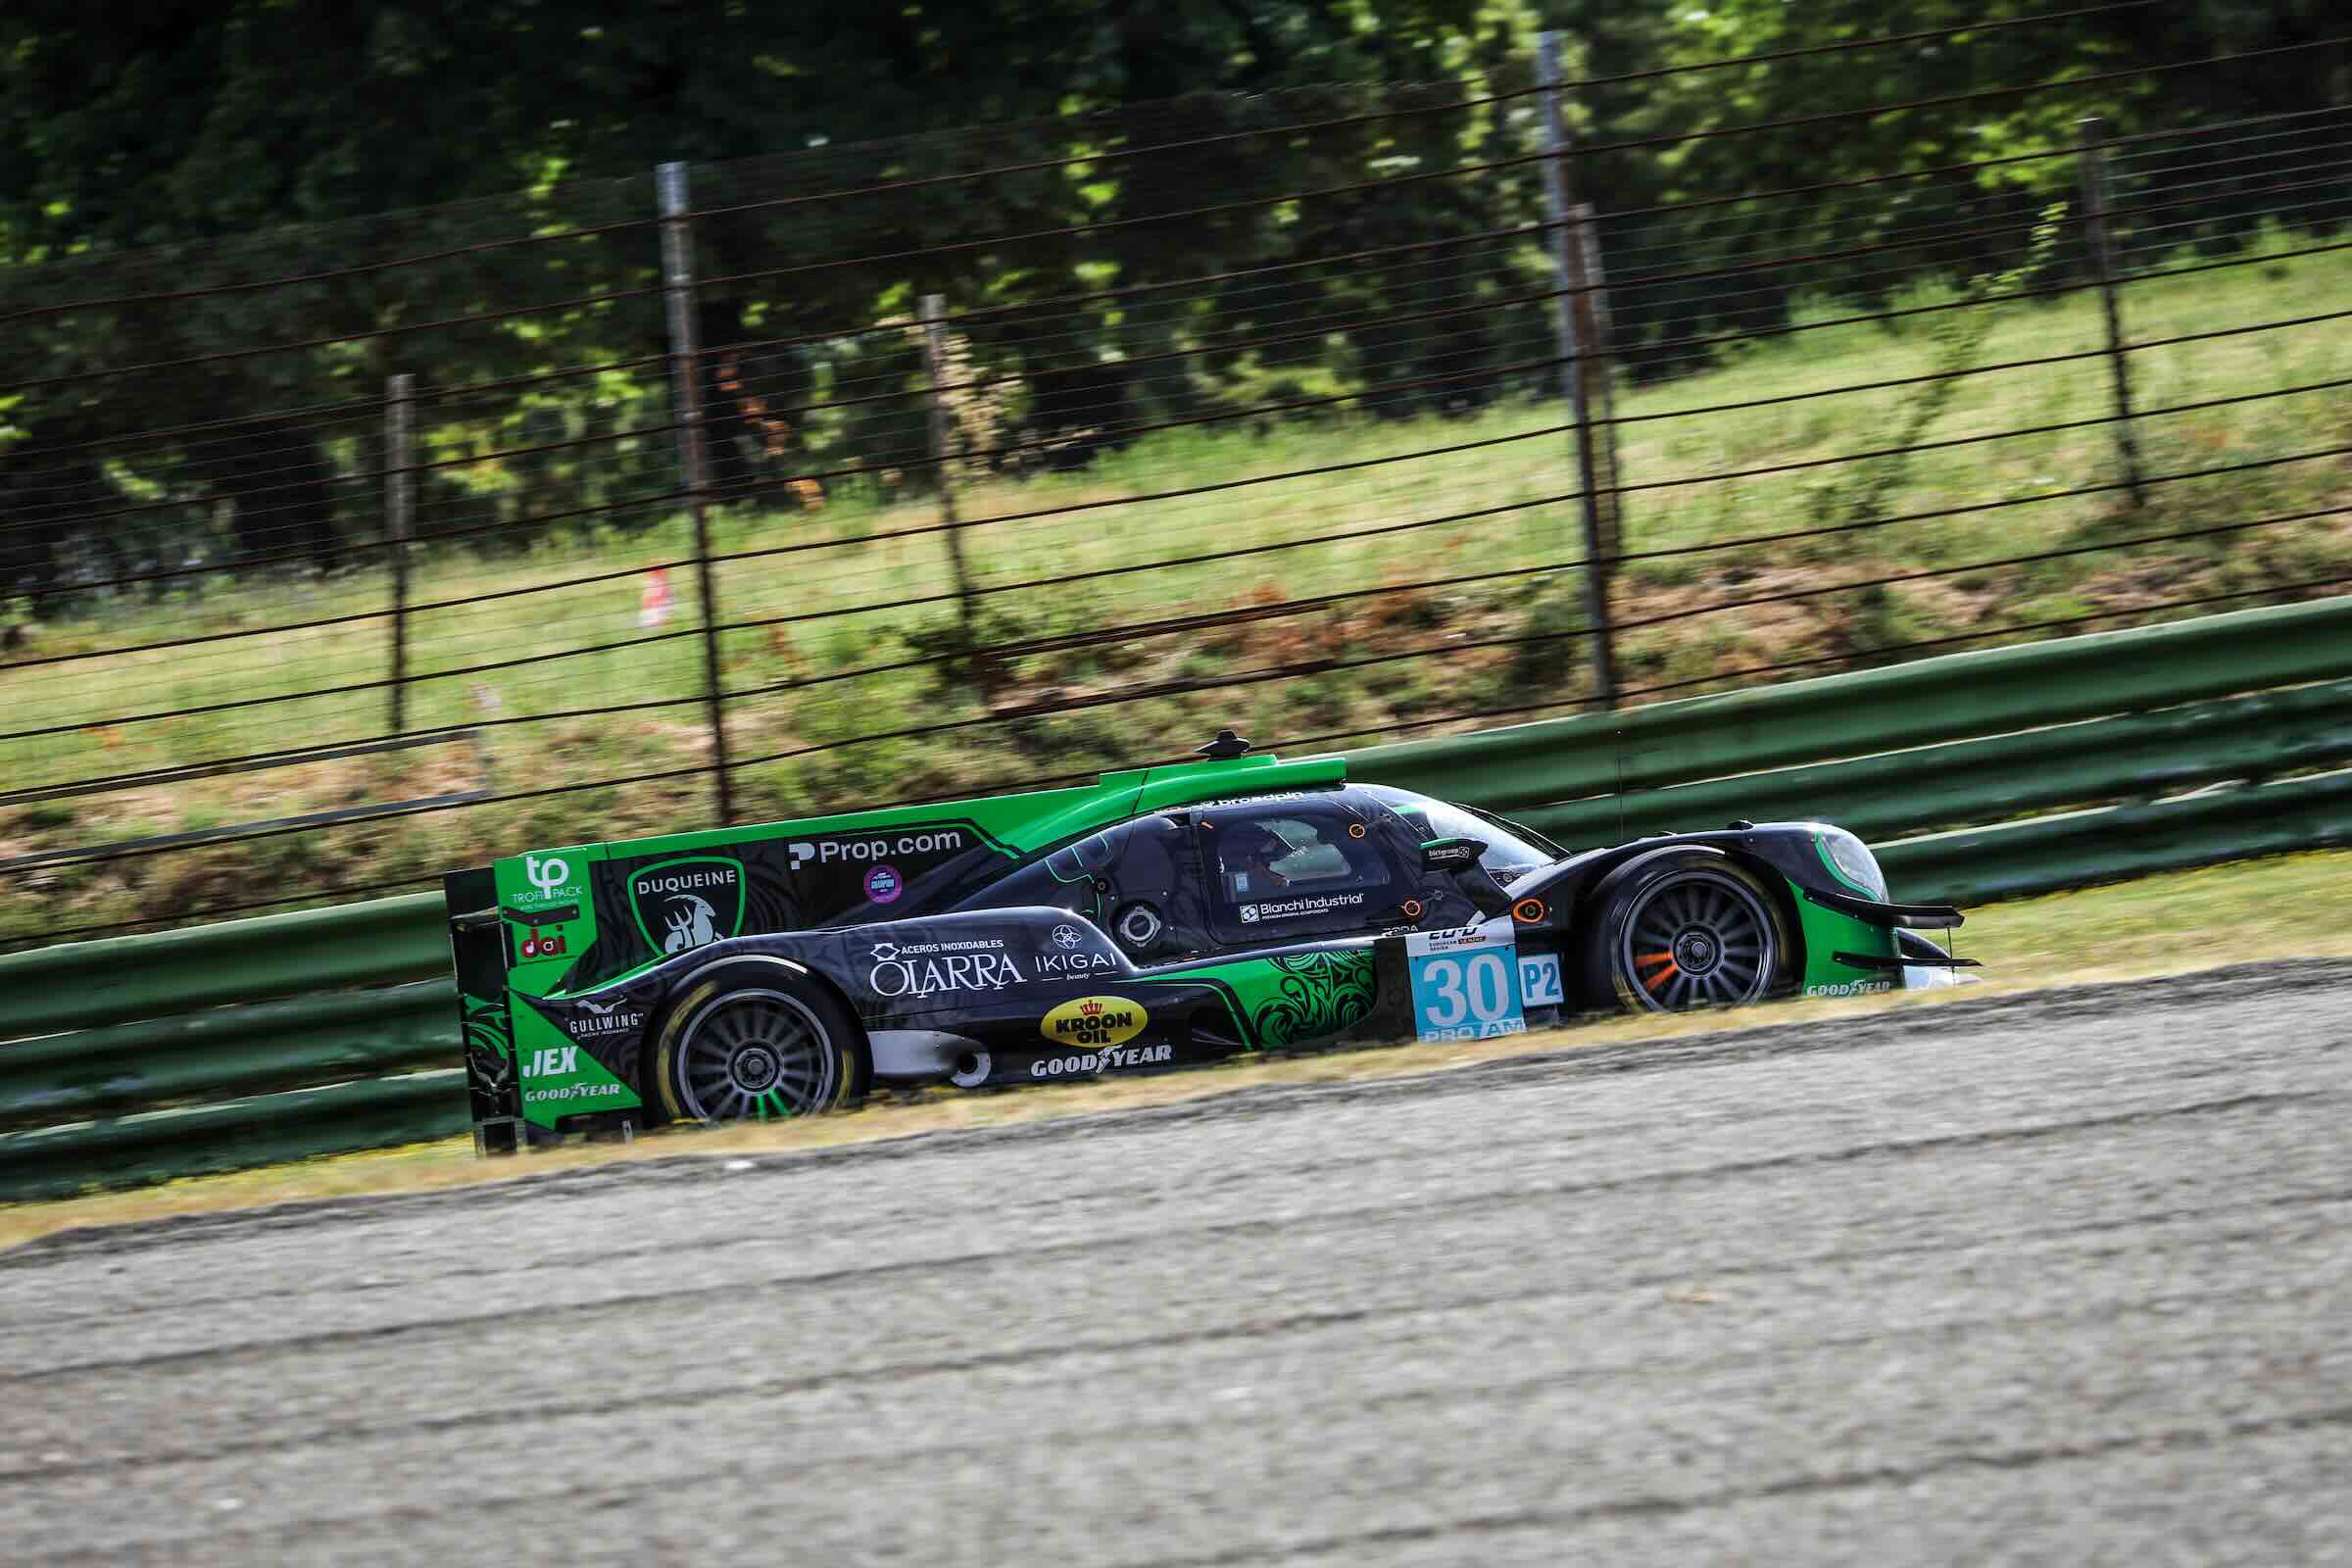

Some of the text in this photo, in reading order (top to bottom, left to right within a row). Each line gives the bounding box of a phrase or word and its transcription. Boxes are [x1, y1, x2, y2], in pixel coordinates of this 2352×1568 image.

[819, 832, 961, 862] Prop.com
[637, 870, 736, 894] DUQUEINE
[1259, 894, 1362, 914] Bianchi Industrial
[901, 939, 1004, 956] ACEROS INOXIDABLES
[1035, 953, 1117, 973] IKIGAI
[1423, 954, 1510, 1027] 30
[1524, 961, 1559, 998] P2
[569, 1012, 639, 1033] GULLWING
[1055, 1011, 1133, 1033] KROON
[1077, 1029, 1112, 1044] OIL
[522, 1046, 578, 1078] JEX
[1031, 1045, 1173, 1077] GOODYEAR
[524, 1082, 620, 1102] GOODYEAR
